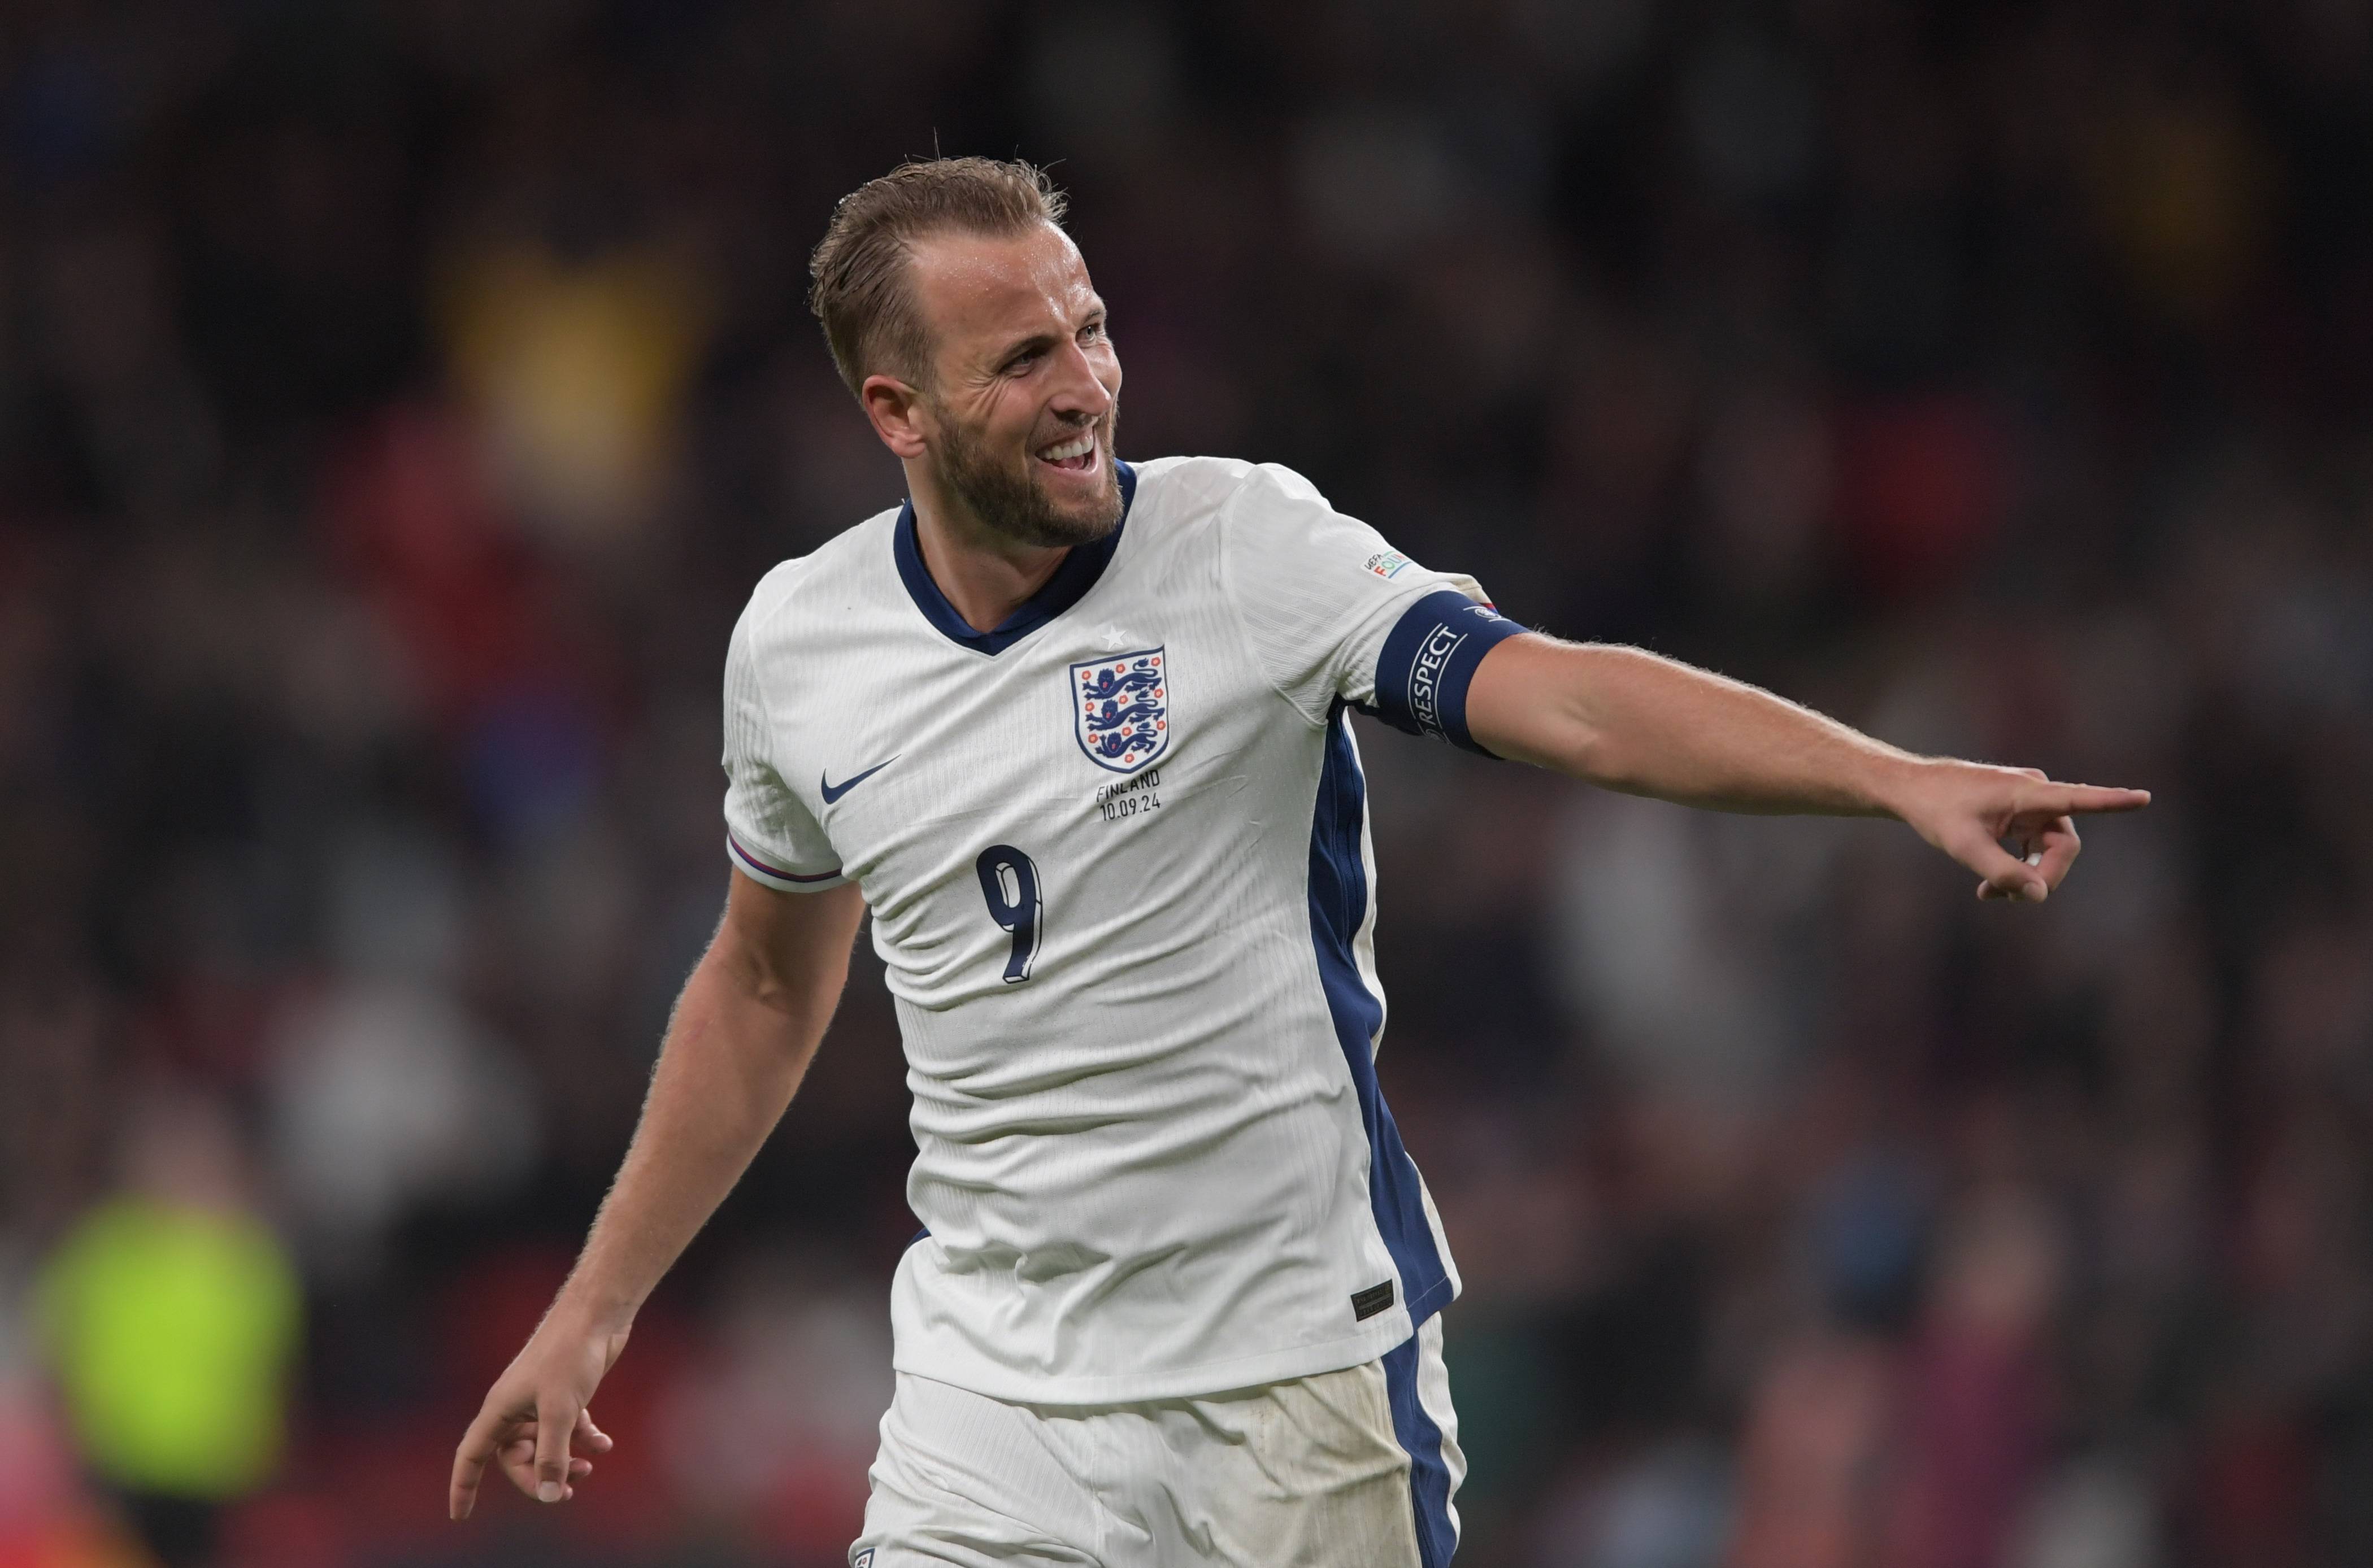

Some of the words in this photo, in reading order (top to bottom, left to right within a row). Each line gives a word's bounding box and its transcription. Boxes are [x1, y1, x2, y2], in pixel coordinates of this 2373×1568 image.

[1364, 554, 1383, 570] UEFA
[1414, 626, 1458, 725] RESPECT
[1097, 769, 1160, 802] FINLAND
[1100, 792, 1161, 821] 10.09.24
[976, 844, 1042, 984] 9
